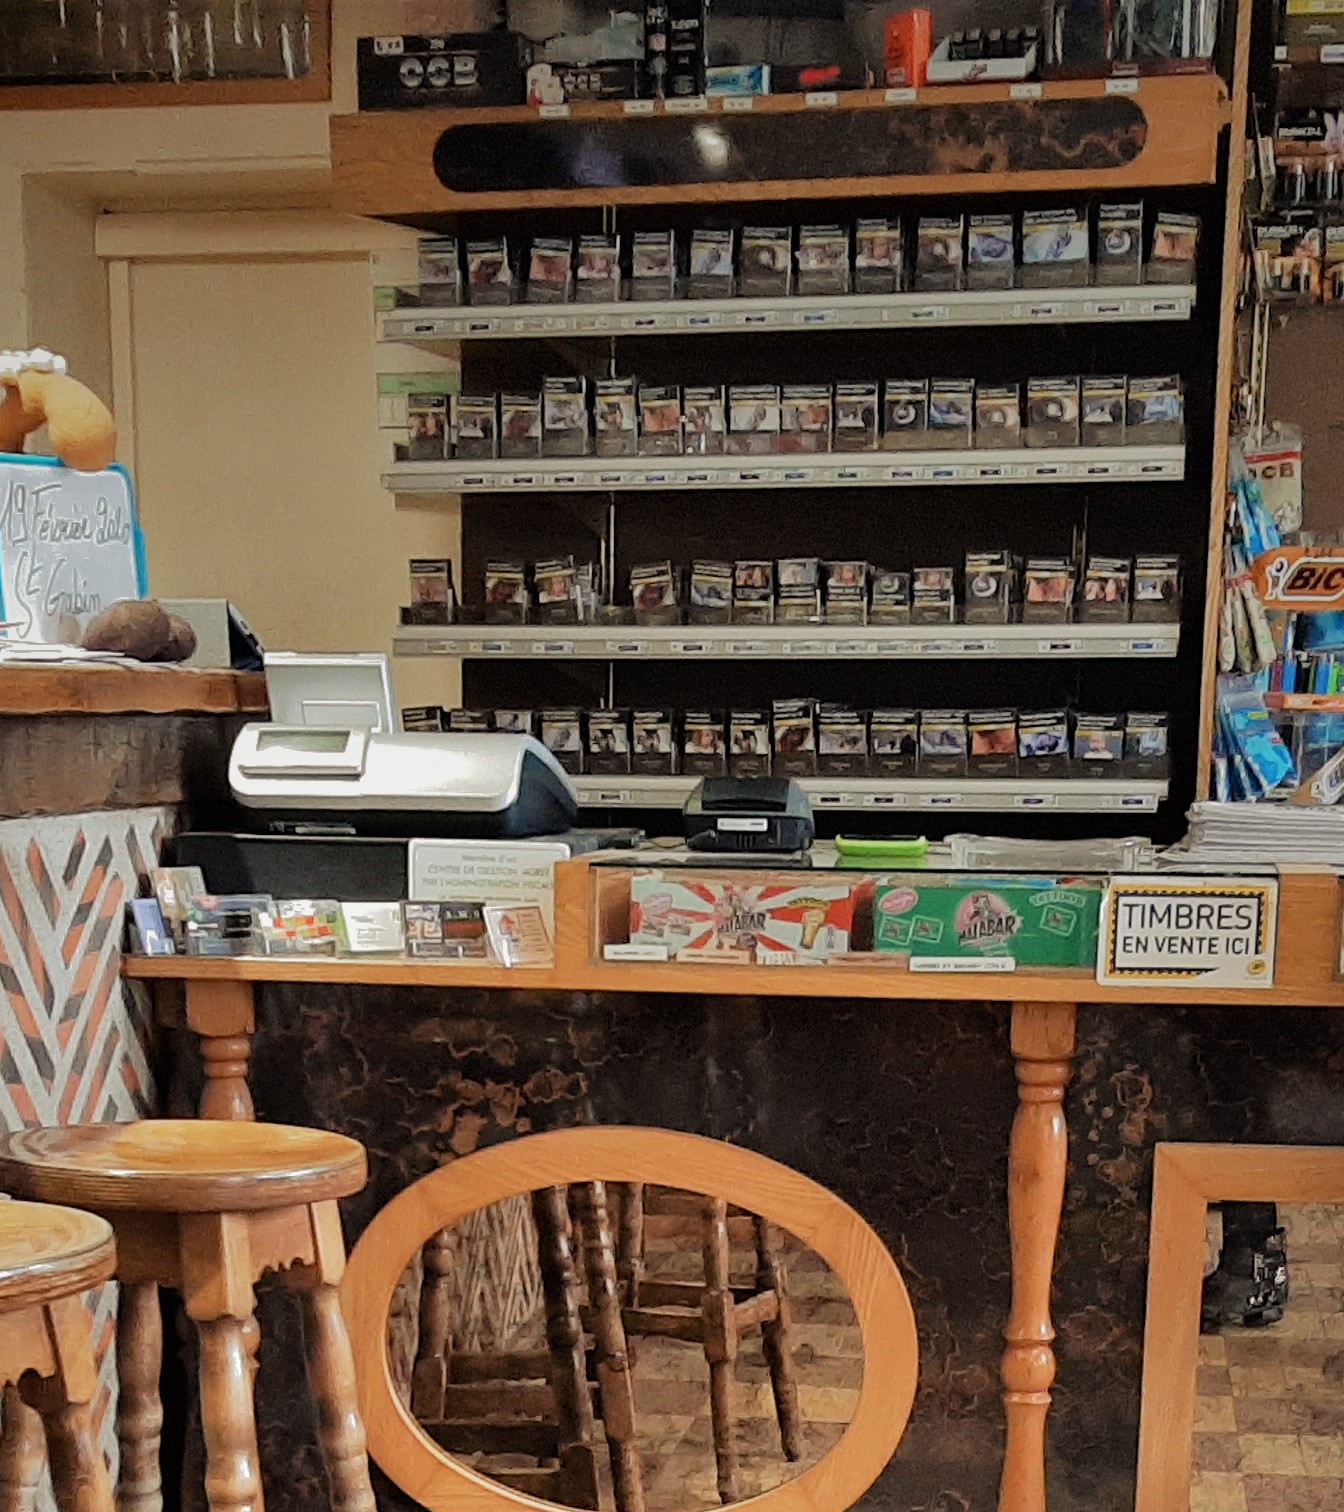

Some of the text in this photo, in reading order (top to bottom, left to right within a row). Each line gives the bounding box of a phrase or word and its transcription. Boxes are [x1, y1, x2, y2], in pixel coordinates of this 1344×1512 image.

[0, 480, 28, 546] 19
[1121, 903, 1253, 930] TIMBRES
[1122, 936, 1250, 955] EN VENTE ICI
